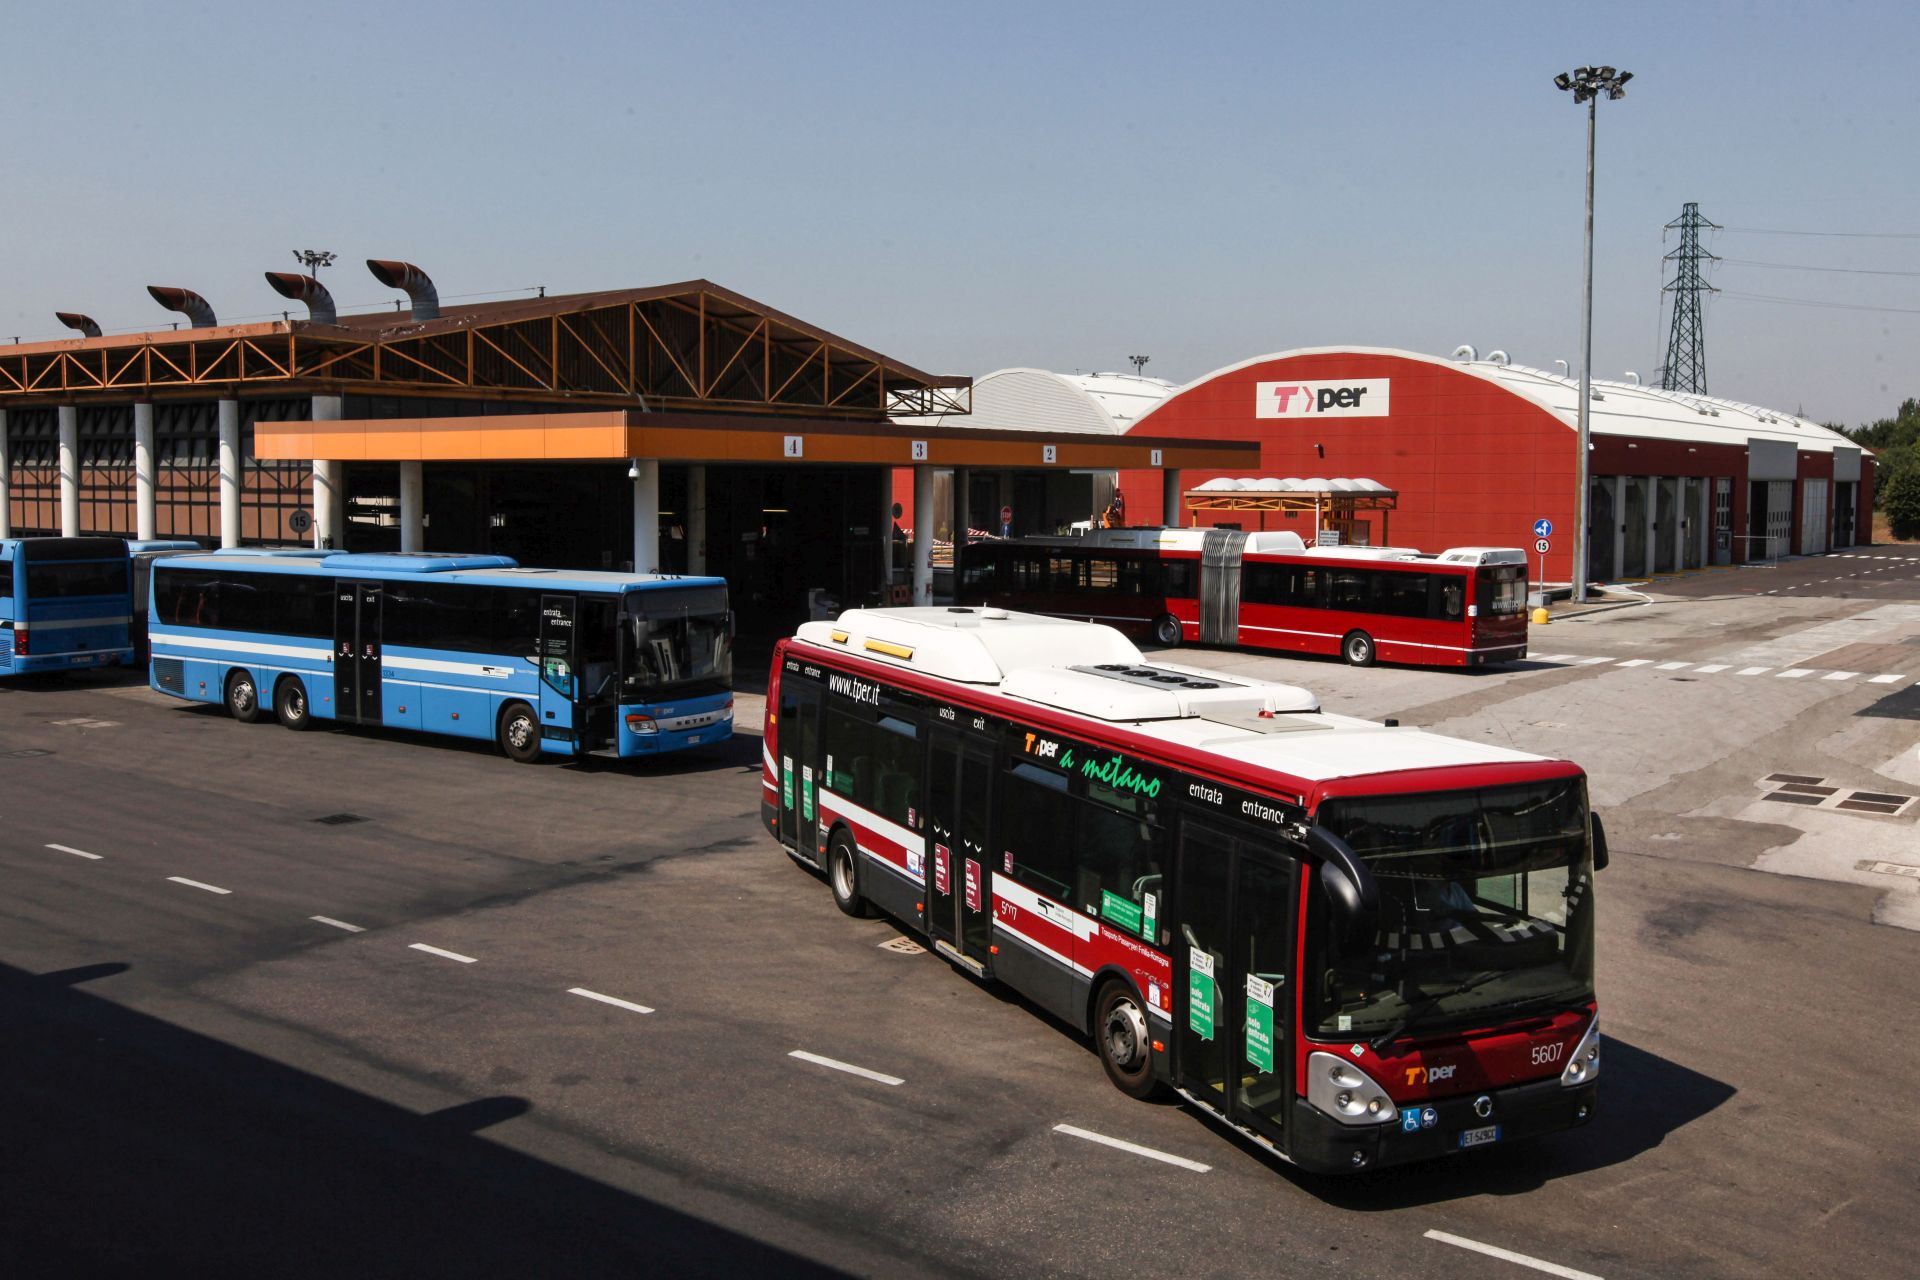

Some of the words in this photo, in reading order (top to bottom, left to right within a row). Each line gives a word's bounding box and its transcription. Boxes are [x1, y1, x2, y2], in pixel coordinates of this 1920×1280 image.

[789, 439, 798, 454] 4
[916, 443, 923, 458] 3
[1047, 447, 1053, 460] 2
[295, 516, 306, 527] 15
[1538, 542, 1547, 551] 15
[543, 608, 561, 617] entrata
[550, 618, 572, 627] entrance
[786, 660, 799, 672] entrata
[804, 665, 821, 678] entrance
[829, 673, 880, 706] www.tper.it
[939, 706, 955, 721] uscita
[973, 716, 985, 731] exit
[1081, 754, 1161, 798] metano
[1189, 782, 1223, 805] entrata
[1191, 997, 1211, 1014] entrata
[1248, 1027, 1269, 1045] entrata
[1531, 1042, 1564, 1065] 5607
